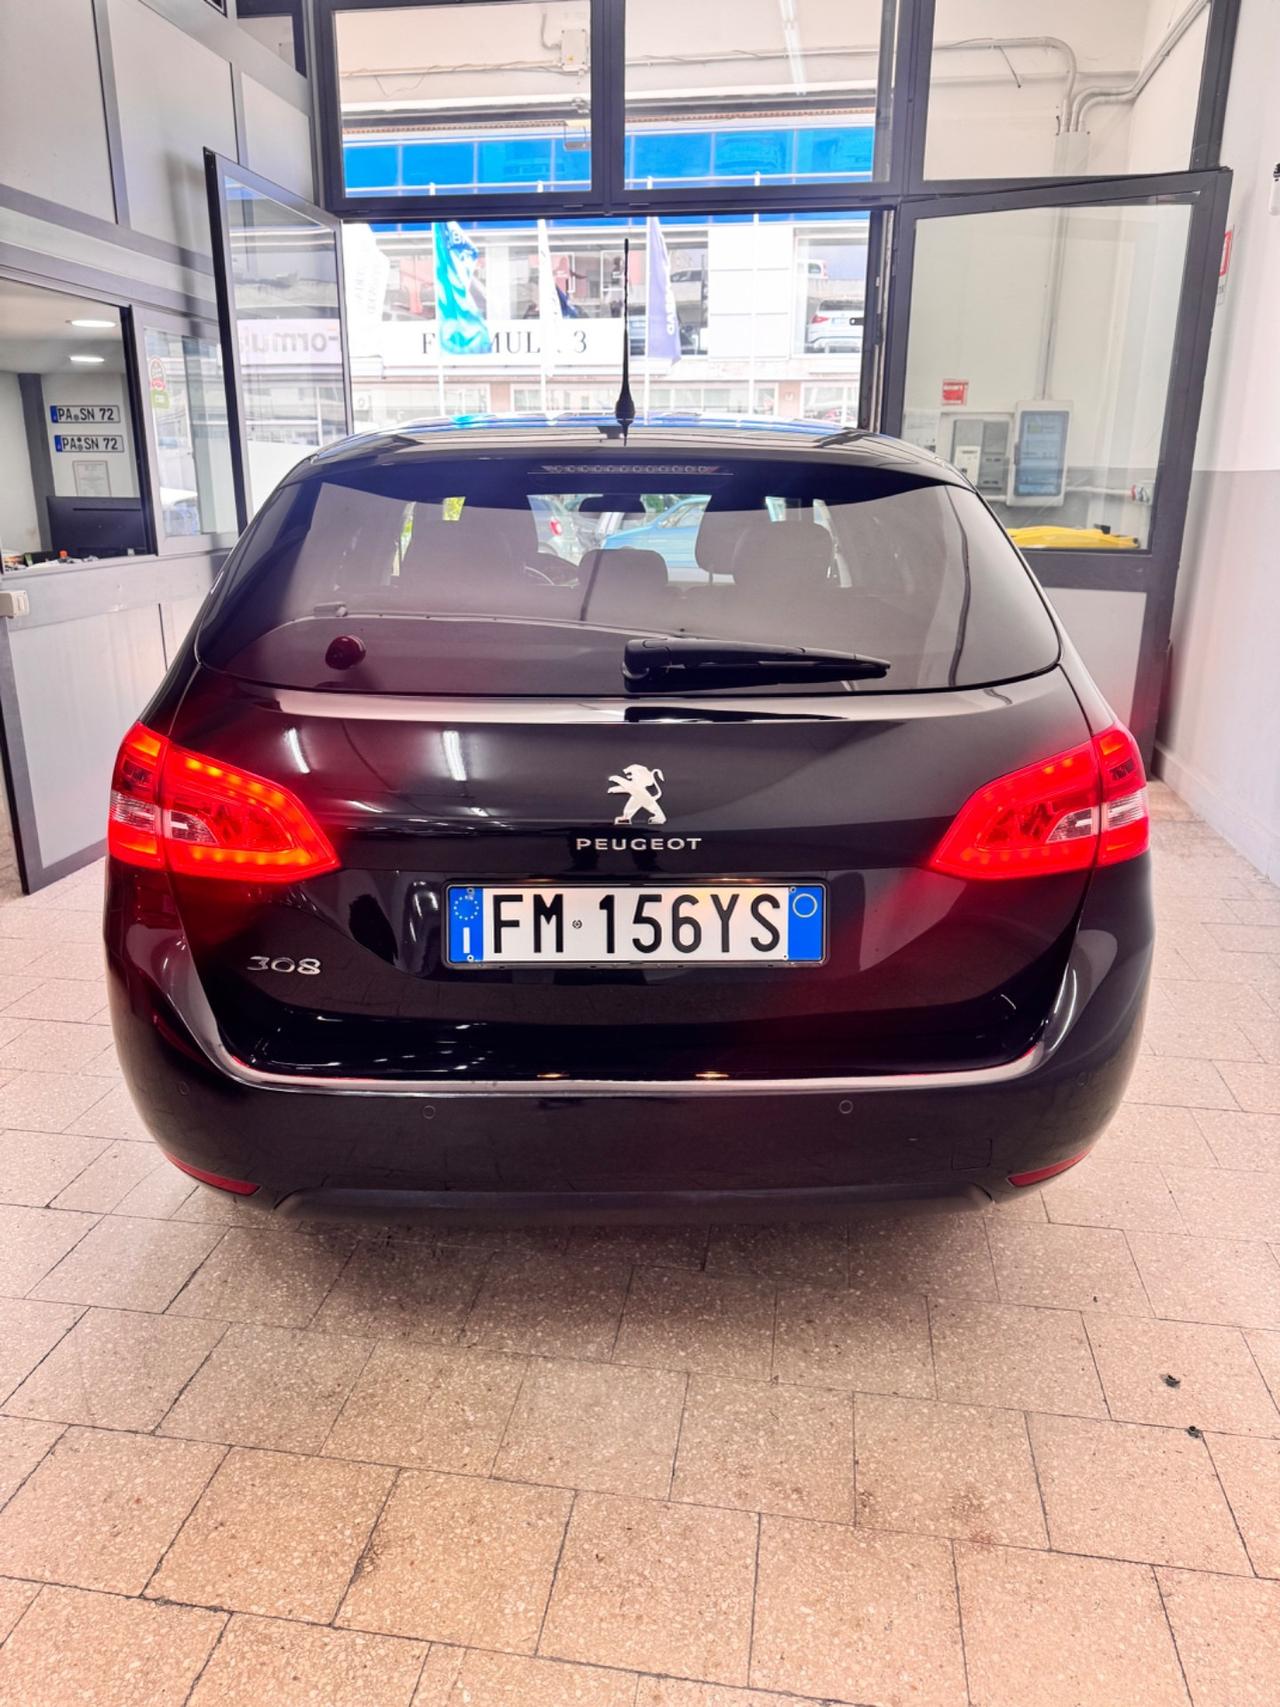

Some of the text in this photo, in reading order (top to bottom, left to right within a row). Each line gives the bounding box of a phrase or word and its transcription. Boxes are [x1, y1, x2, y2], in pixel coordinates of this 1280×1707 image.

[57, 407, 115, 421] PA SN 72
[84, 437, 99, 450] SN
[103, 437, 119, 450] 72
[575, 838, 702, 851] PEUGEOT
[493, 893, 564, 954] FM
[598, 893, 782, 954] 156YS
[247, 955, 321, 976] 308
